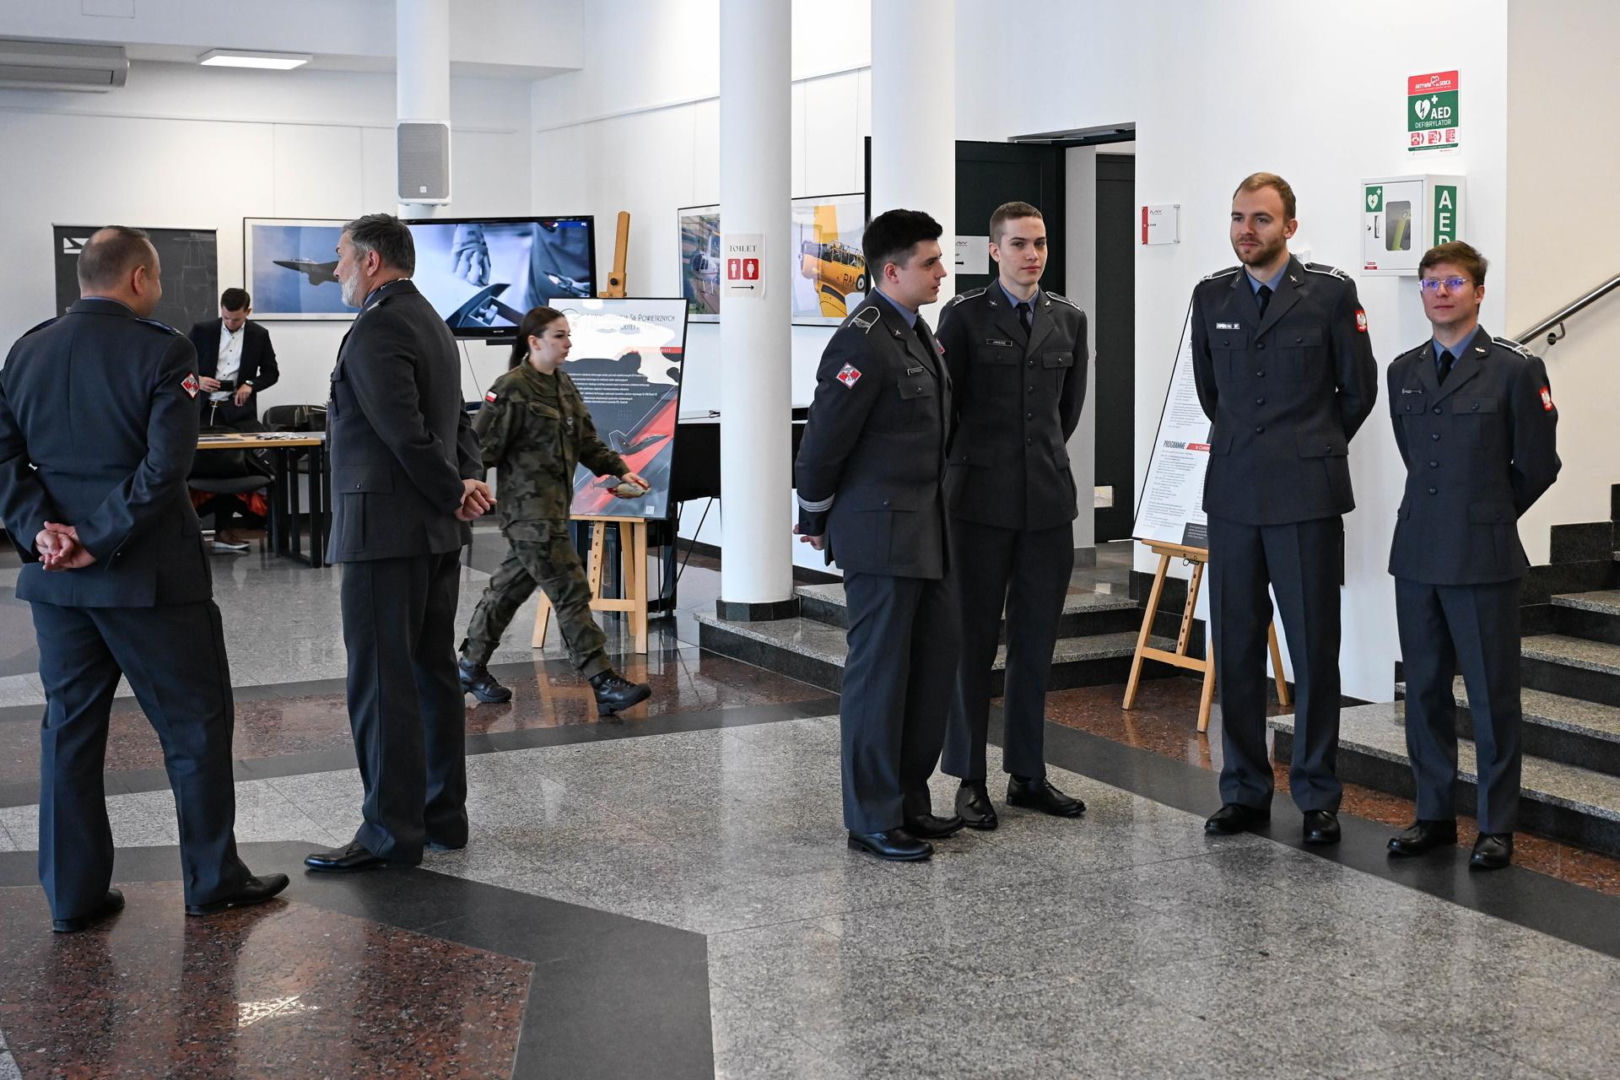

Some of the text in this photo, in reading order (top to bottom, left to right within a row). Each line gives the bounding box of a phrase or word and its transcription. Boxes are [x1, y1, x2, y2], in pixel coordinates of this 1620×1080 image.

[1430, 107, 1452, 119] AED
[1415, 119, 1452, 128] DEFIBRYLATOR
[728, 244, 758, 253] TOILET
